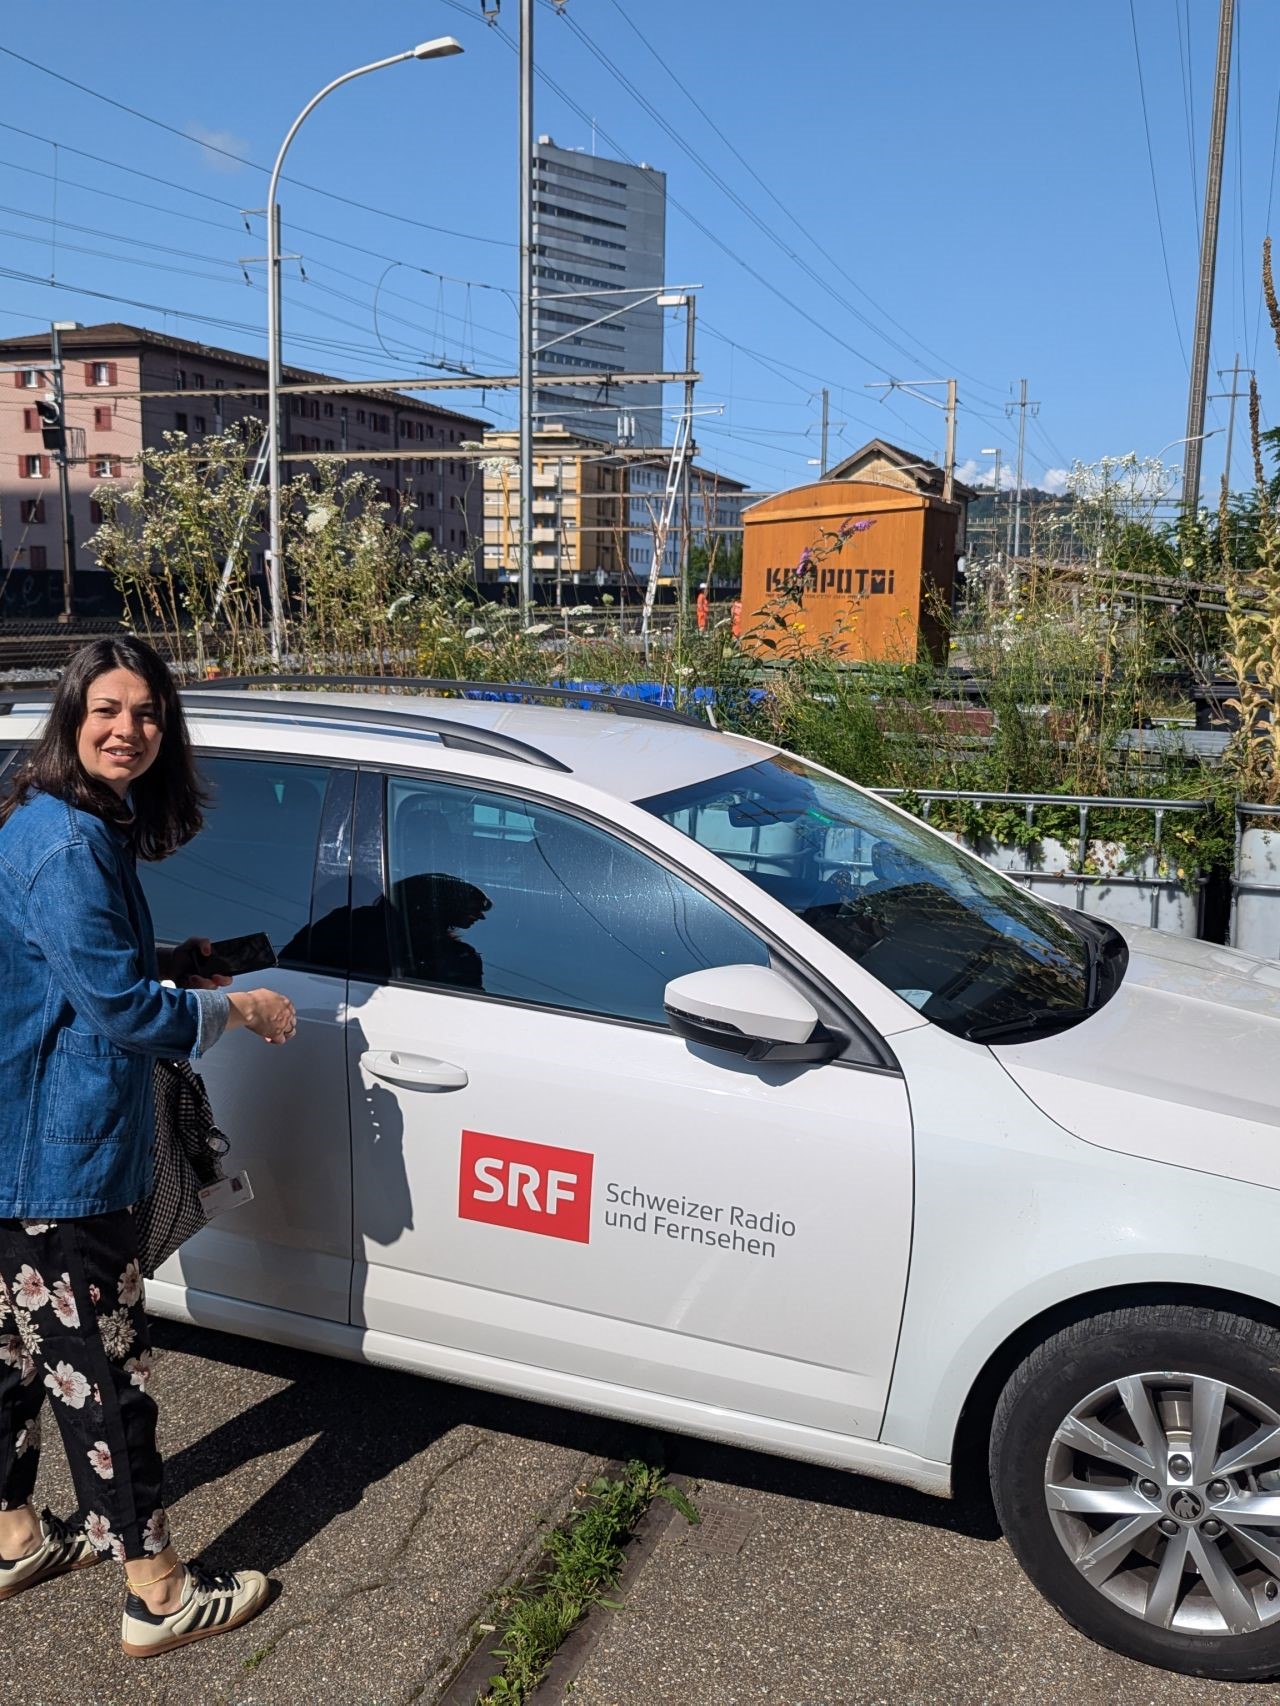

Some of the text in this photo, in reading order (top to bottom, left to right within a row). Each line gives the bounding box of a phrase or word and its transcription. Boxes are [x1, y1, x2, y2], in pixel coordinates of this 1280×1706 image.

[473, 1157, 577, 1215] SRF
[605, 1182, 796, 1237] Schweizer Radio
[605, 1210, 776, 1258] und Fernsehen
